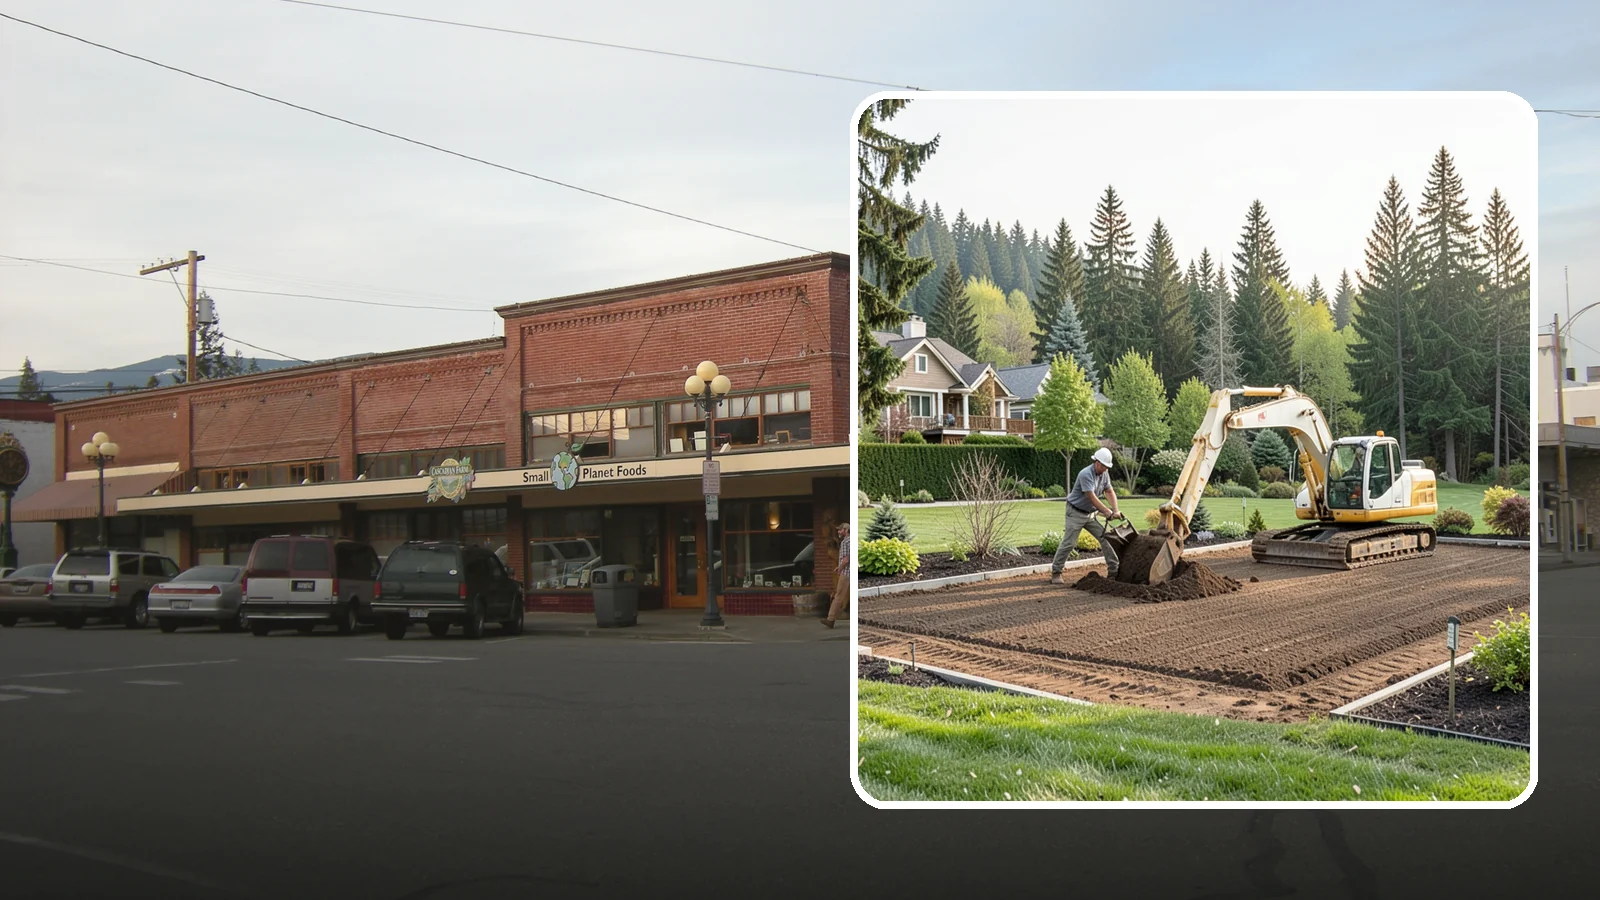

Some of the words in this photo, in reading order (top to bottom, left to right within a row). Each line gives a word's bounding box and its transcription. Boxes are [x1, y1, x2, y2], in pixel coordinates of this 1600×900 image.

[523, 471, 549, 483] Small
[583, 468, 614, 479] Planet
[617, 464, 647, 477] Foods
